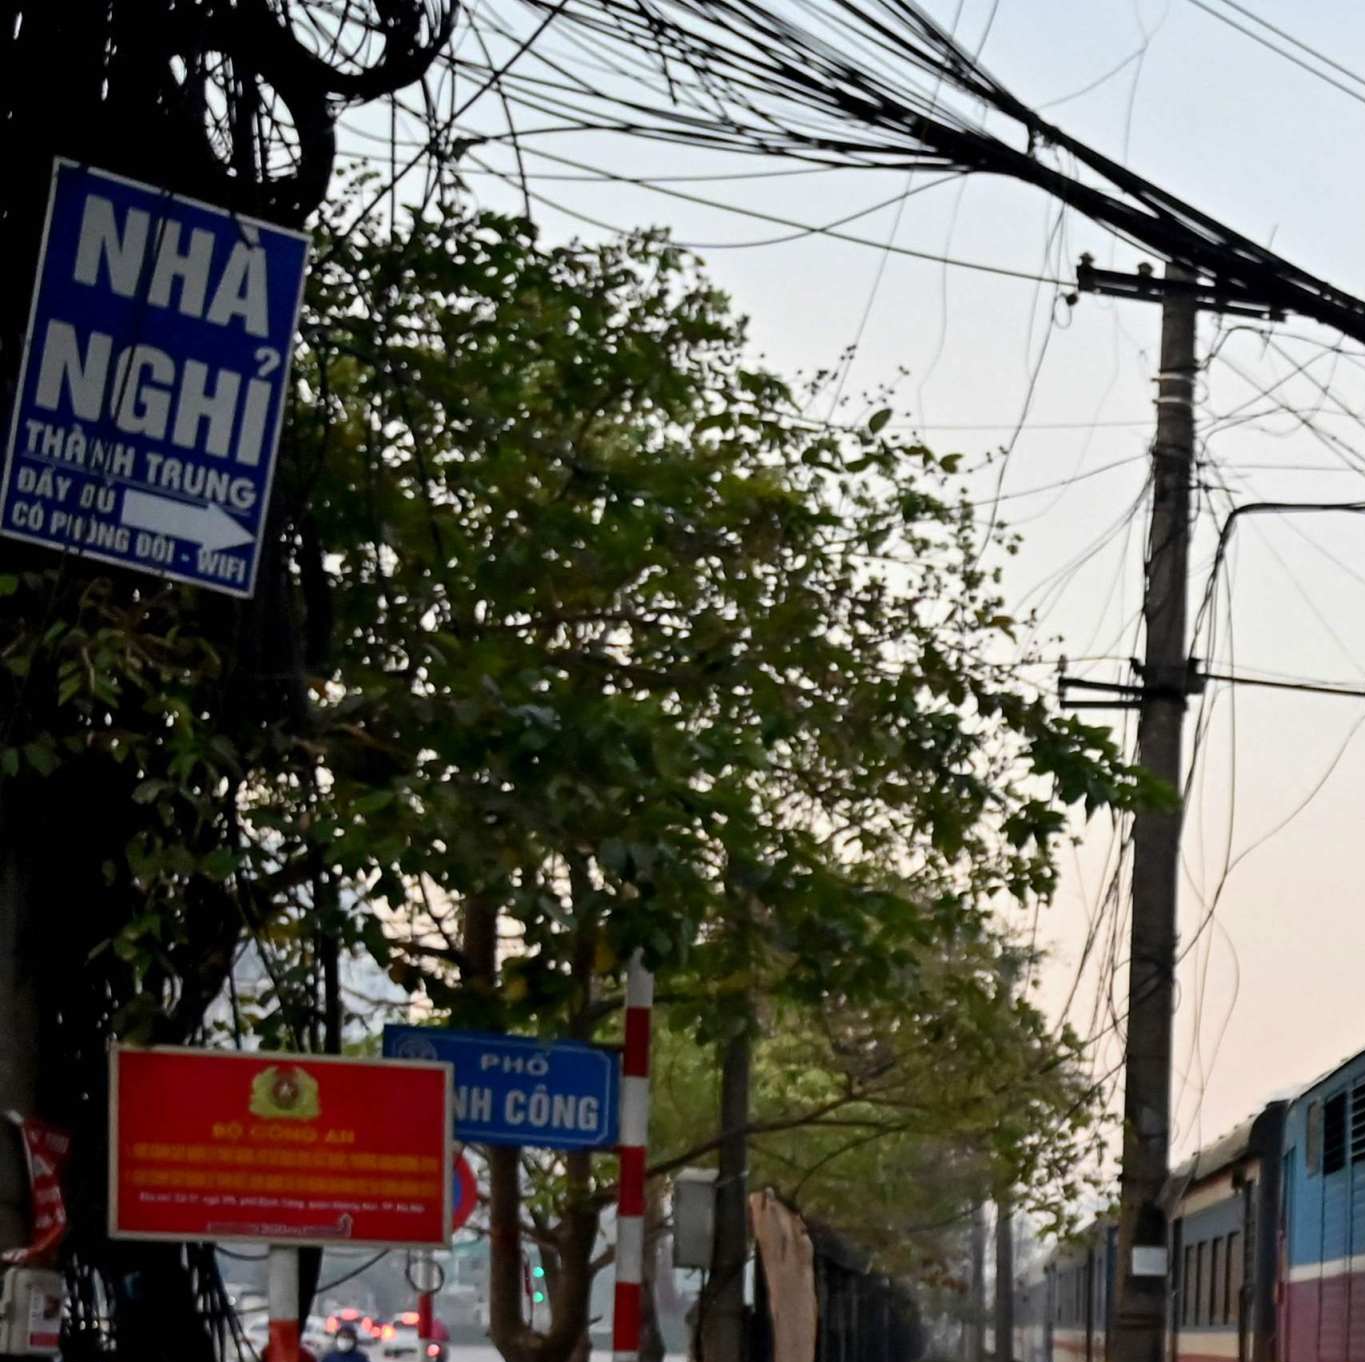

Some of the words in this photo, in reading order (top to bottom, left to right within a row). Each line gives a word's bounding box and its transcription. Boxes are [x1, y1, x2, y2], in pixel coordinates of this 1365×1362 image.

[73, 193, 270, 339] NHÀ
[35, 318, 281, 467] NGHỈ
[145, 451, 257, 509] TRUNG
[195, 545, 248, 584] WIFI
[480, 1050, 550, 1076] PHỐ
[453, 1085, 493, 1123] NH
[505, 1084, 600, 1132] CÔNG
